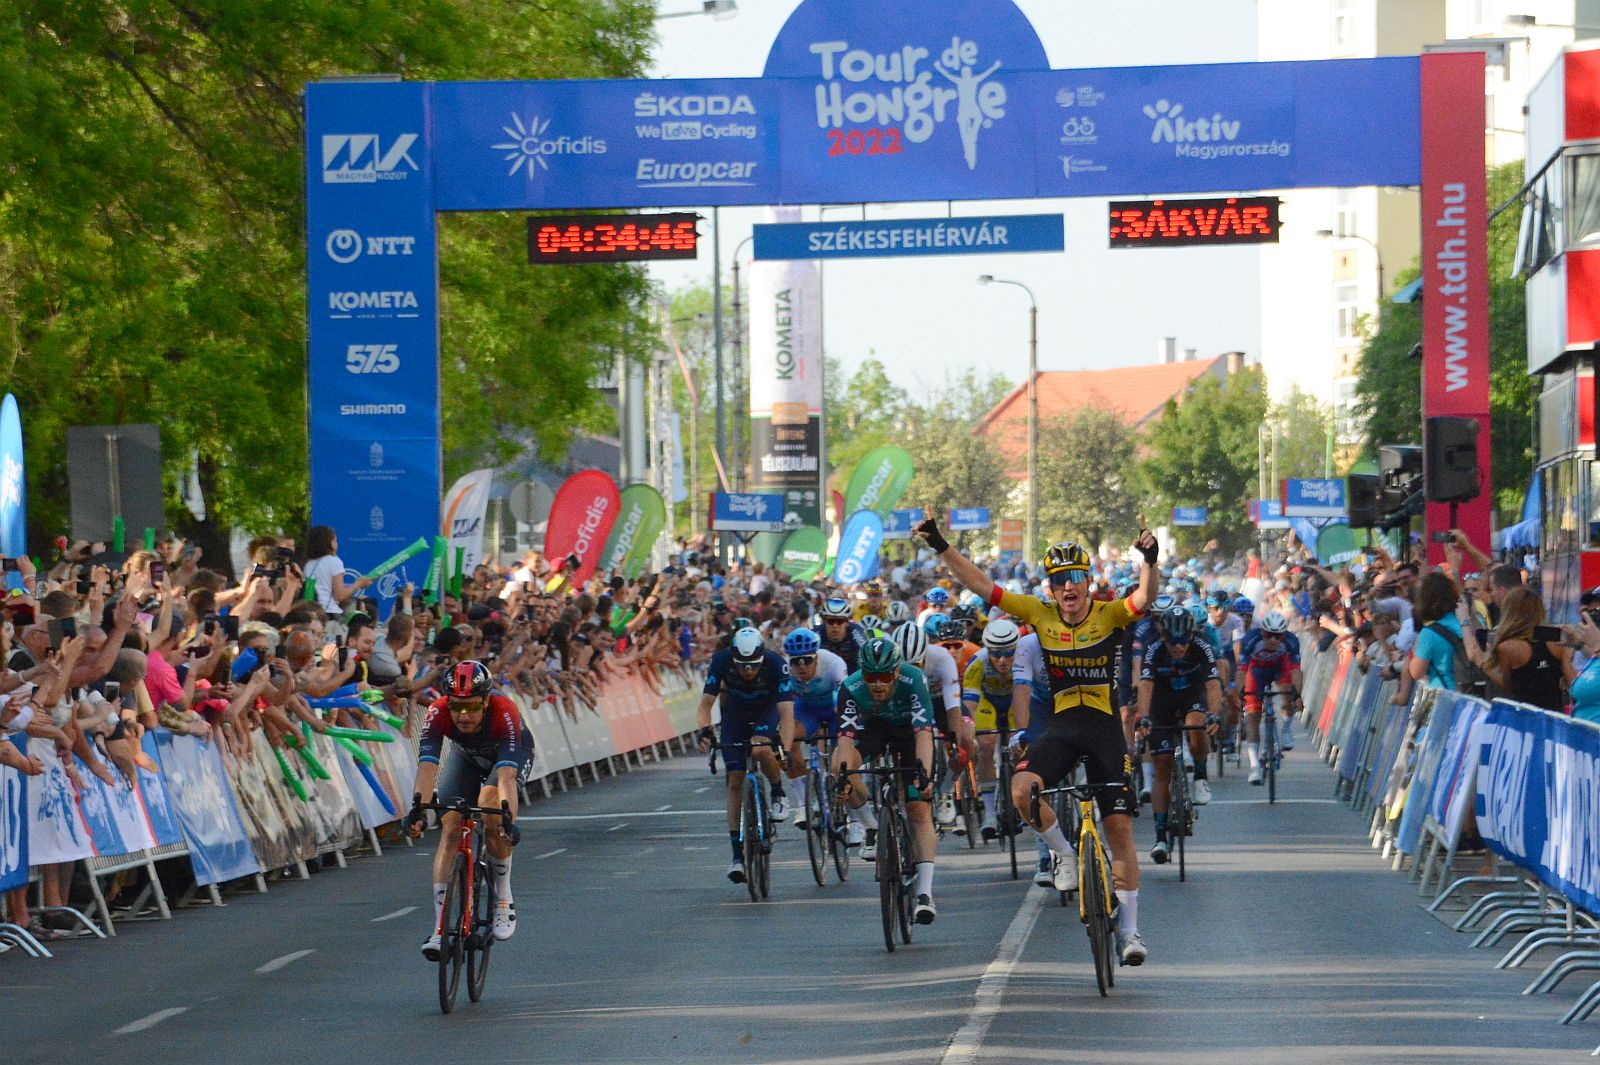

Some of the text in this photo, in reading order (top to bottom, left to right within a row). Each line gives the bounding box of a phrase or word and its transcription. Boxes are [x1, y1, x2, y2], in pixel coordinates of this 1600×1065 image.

[809, 36, 978, 83] Tour de
[634, 92, 757, 117] ŠKODA
[521, 136, 608, 156] Cofidis
[635, 125, 661, 139] We
[702, 123, 757, 140] Cycling
[827, 127, 904, 157] 2022
[1175, 140, 1291, 160] Magyarország
[636, 159, 758, 184] Europcar
[366, 236, 416, 256] NTT
[536, 221, 697, 253] 04:34:46
[807, 223, 1010, 252] SZÉKESFEHÉRVÁR
[328, 290, 419, 312] KOMETA
[1436, 182, 1469, 393] www.tdh.hu
[774, 288, 797, 381] KOMETA
[345, 343, 401, 374] 575
[340, 403, 407, 416] SHIMANO
[856, 524, 877, 560] NTT
[1049, 654, 1108, 667] JUMBO
[1067, 667, 1108, 679] VISMA
[1113, 644, 1123, 690] HEMA
[420, 705, 440, 741] INEOS
[503, 712, 516, 752] GRENADIER
